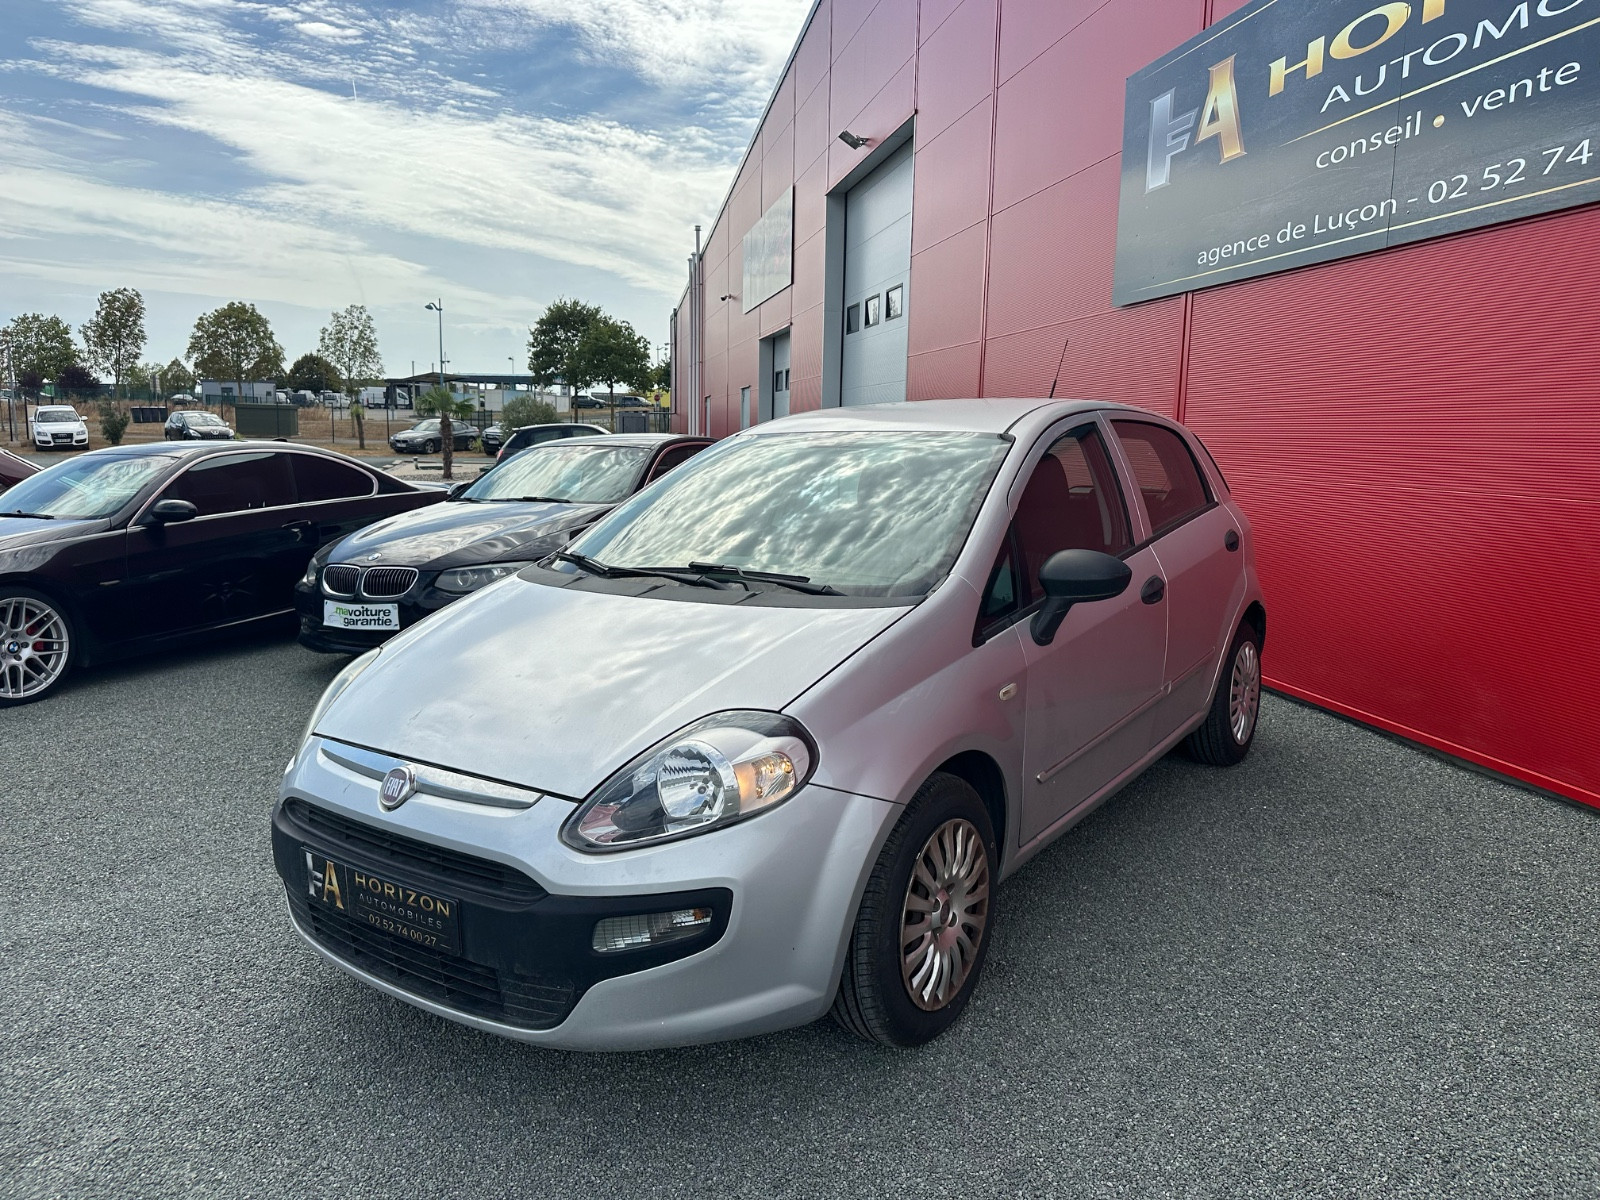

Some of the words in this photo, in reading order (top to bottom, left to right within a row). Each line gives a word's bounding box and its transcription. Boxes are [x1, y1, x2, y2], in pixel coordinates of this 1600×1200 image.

[1315, 110, 1422, 169] conseil
[1461, 61, 1581, 118] vente
[1197, 233, 1271, 266] agence
[1276, 221, 1306, 244] de
[1313, 198, 1397, 235] Luçon
[1428, 174, 1468, 204] 02
[1480, 158, 1526, 191] 52
[1541, 138, 1593, 176] 74
[343, 617, 392, 627] garantie
[354, 871, 450, 918] HORIZON
[359, 893, 443, 930] AUTOMOBILES
[368, 913, 381, 927] 02
[382, 920, 395, 933] 52
[396, 924, 408, 936] 74
[410, 929, 423, 942] 00
[424, 934, 437, 948] 27
